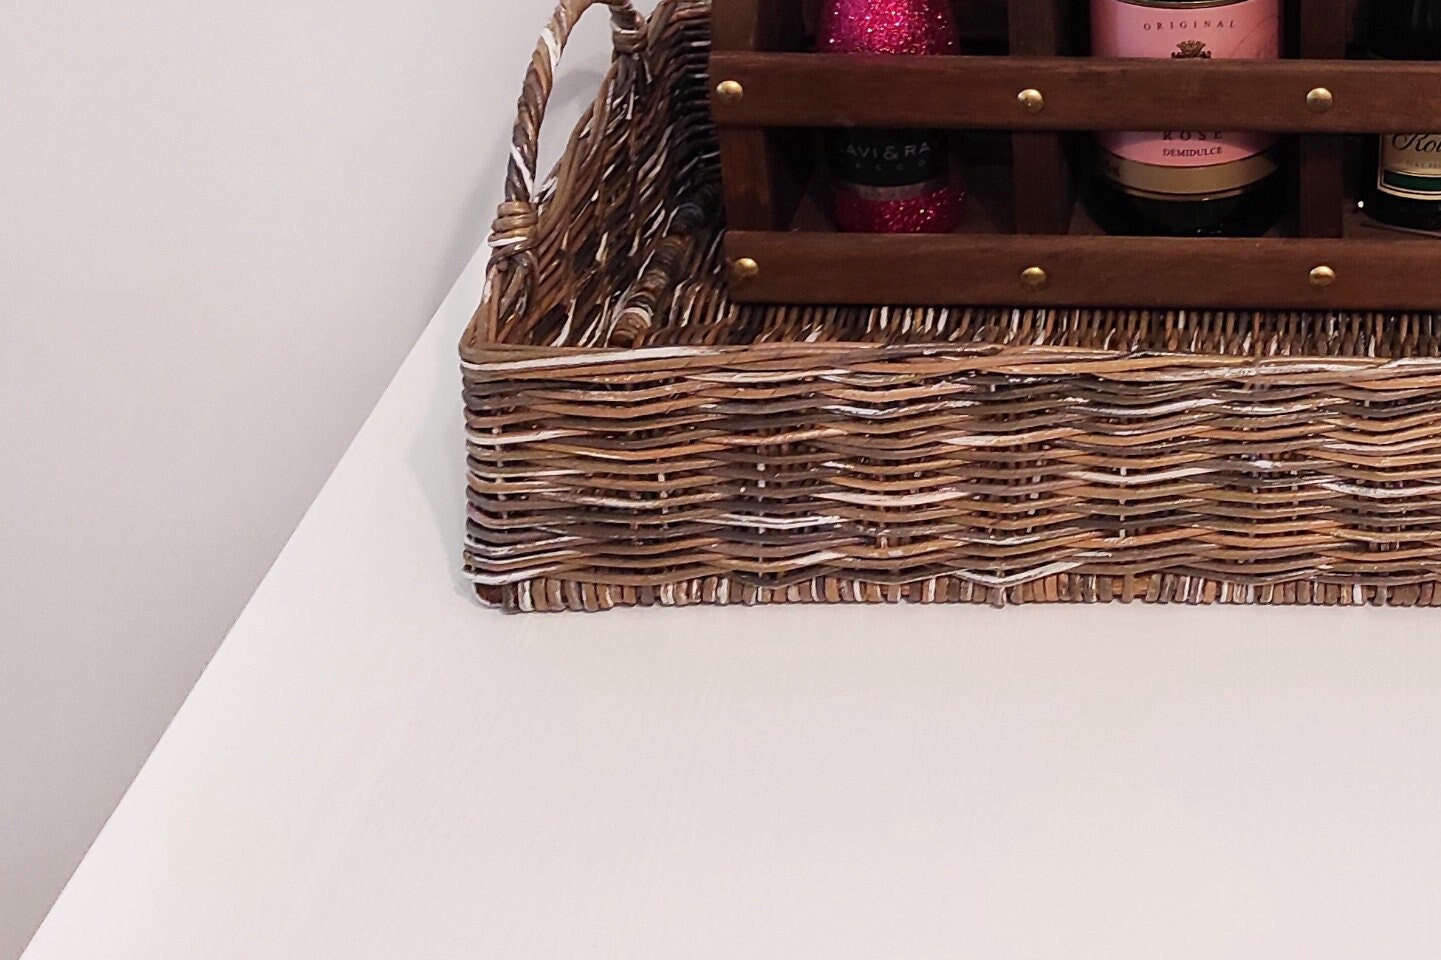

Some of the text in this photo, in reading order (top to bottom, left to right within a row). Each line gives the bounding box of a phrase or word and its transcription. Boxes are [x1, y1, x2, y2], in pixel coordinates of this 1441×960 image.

[1143, 19, 1236, 31] ORIGINAL
[904, 142, 931, 157] RA
[1162, 146, 1223, 158] DEMIDULCE
